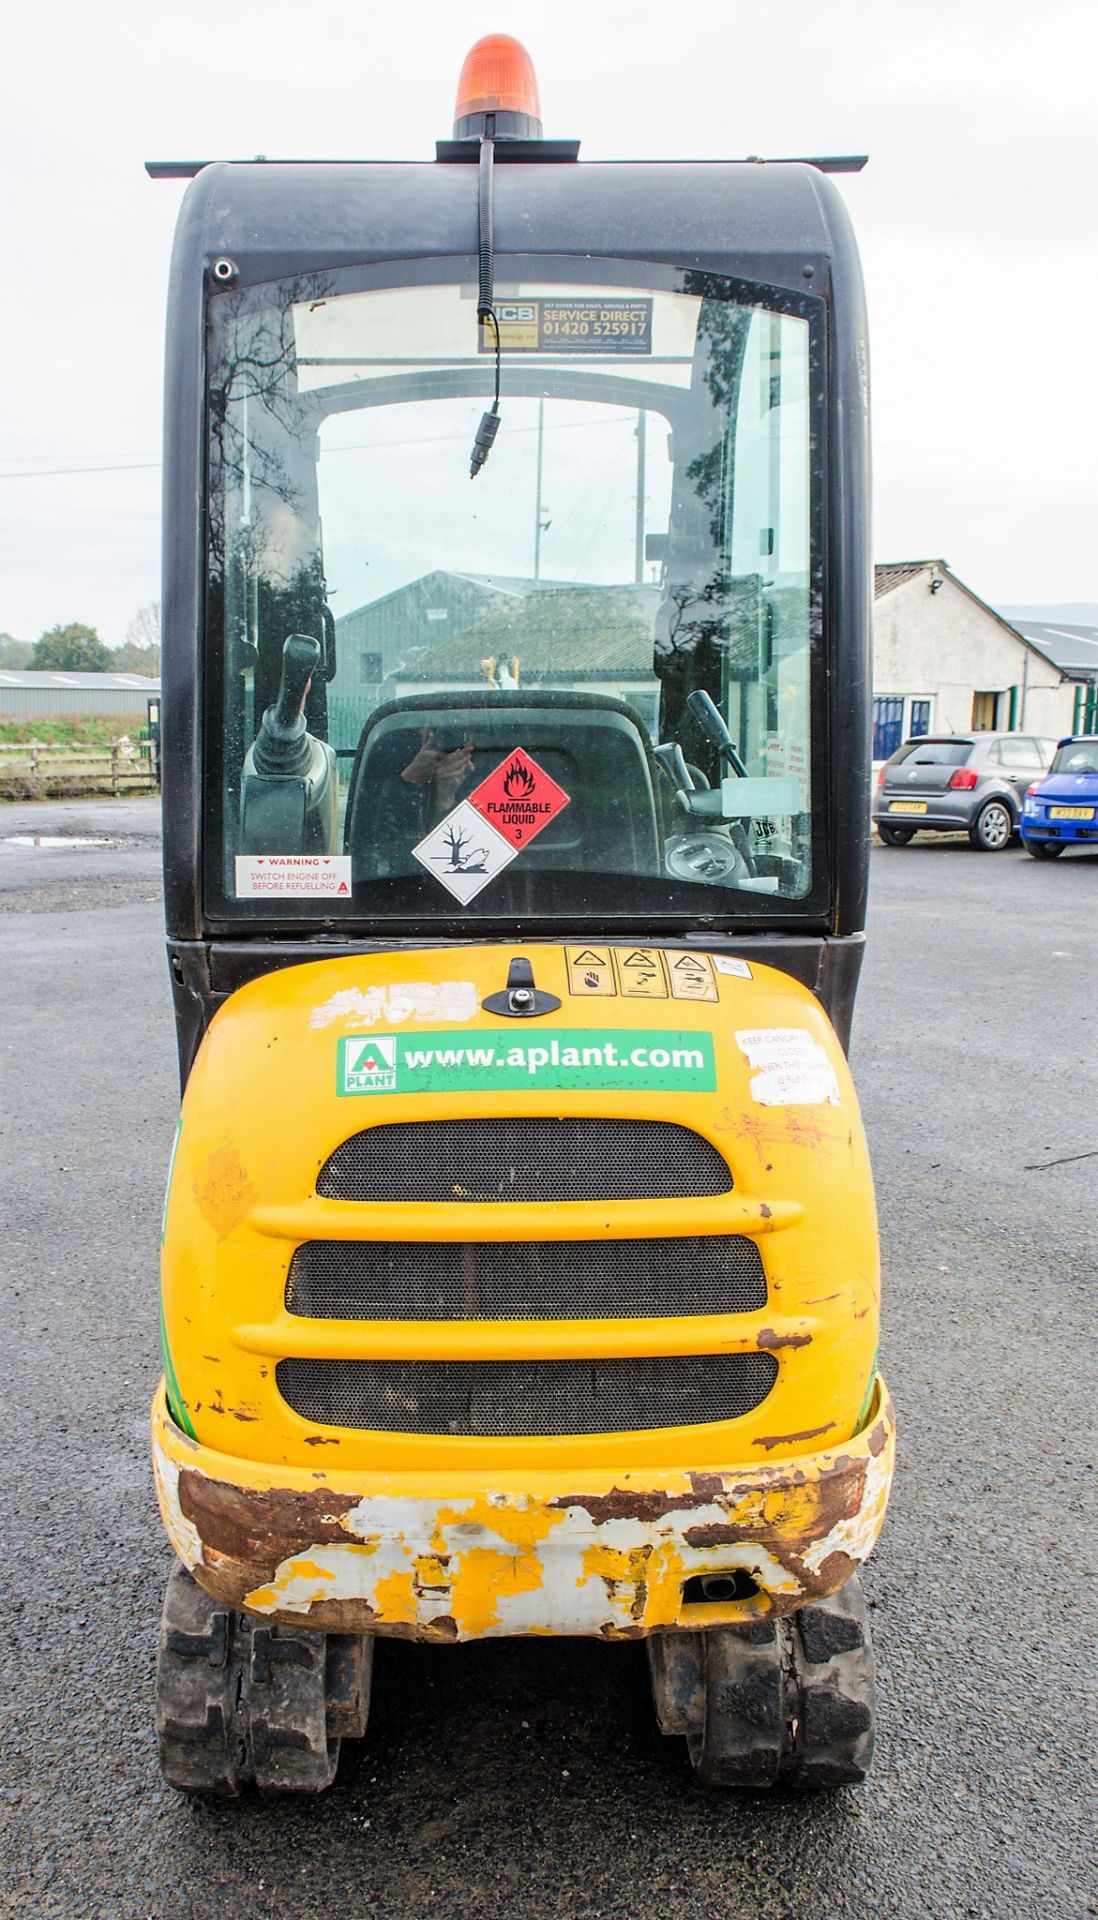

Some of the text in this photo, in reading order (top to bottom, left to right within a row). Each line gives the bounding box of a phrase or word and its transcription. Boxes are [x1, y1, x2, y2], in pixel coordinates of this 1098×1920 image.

[488, 307, 534, 321] JCB
[543, 311, 647, 321] SERVICE DIRECT
[543, 323, 647, 336] 01420 525917
[487, 803, 551, 813] FLAMMABLE
[502, 814, 535, 825] LIQUID
[515, 829, 522, 840] 3
[756, 821, 776, 837] JCB
[269, 858, 320, 866] WARNING
[250, 872, 337, 880] SWITCH ENGINE OFF
[252, 882, 336, 890] BEFORE REFUELLING
[404, 1040, 704, 1074] www.aplant.com
[347, 1075, 394, 1087] PLANT
